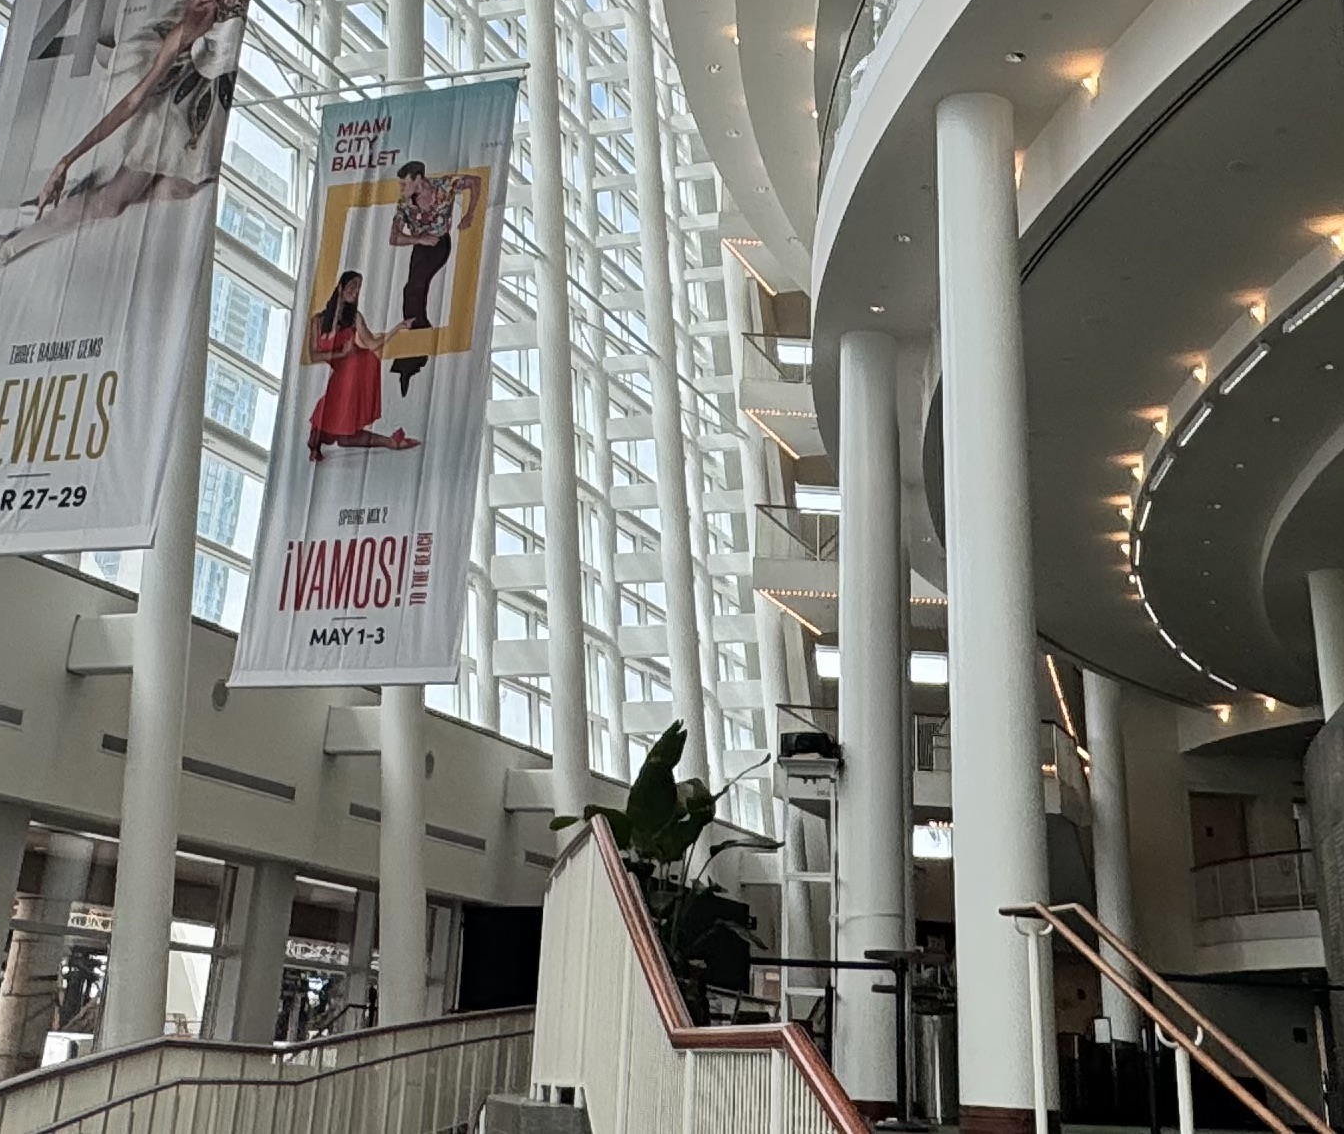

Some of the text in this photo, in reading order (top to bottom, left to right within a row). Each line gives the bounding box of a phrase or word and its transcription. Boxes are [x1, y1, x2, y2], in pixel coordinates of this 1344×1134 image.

[336, 116, 393, 138] MIAMI
[335, 135, 379, 154] CITY
[331, 149, 401, 172] BALLET
[20, 485, 88, 510] 27-29
[278, 535, 408, 612] ¡VAMOS!
[309, 626, 386, 647] MAY 1-3
